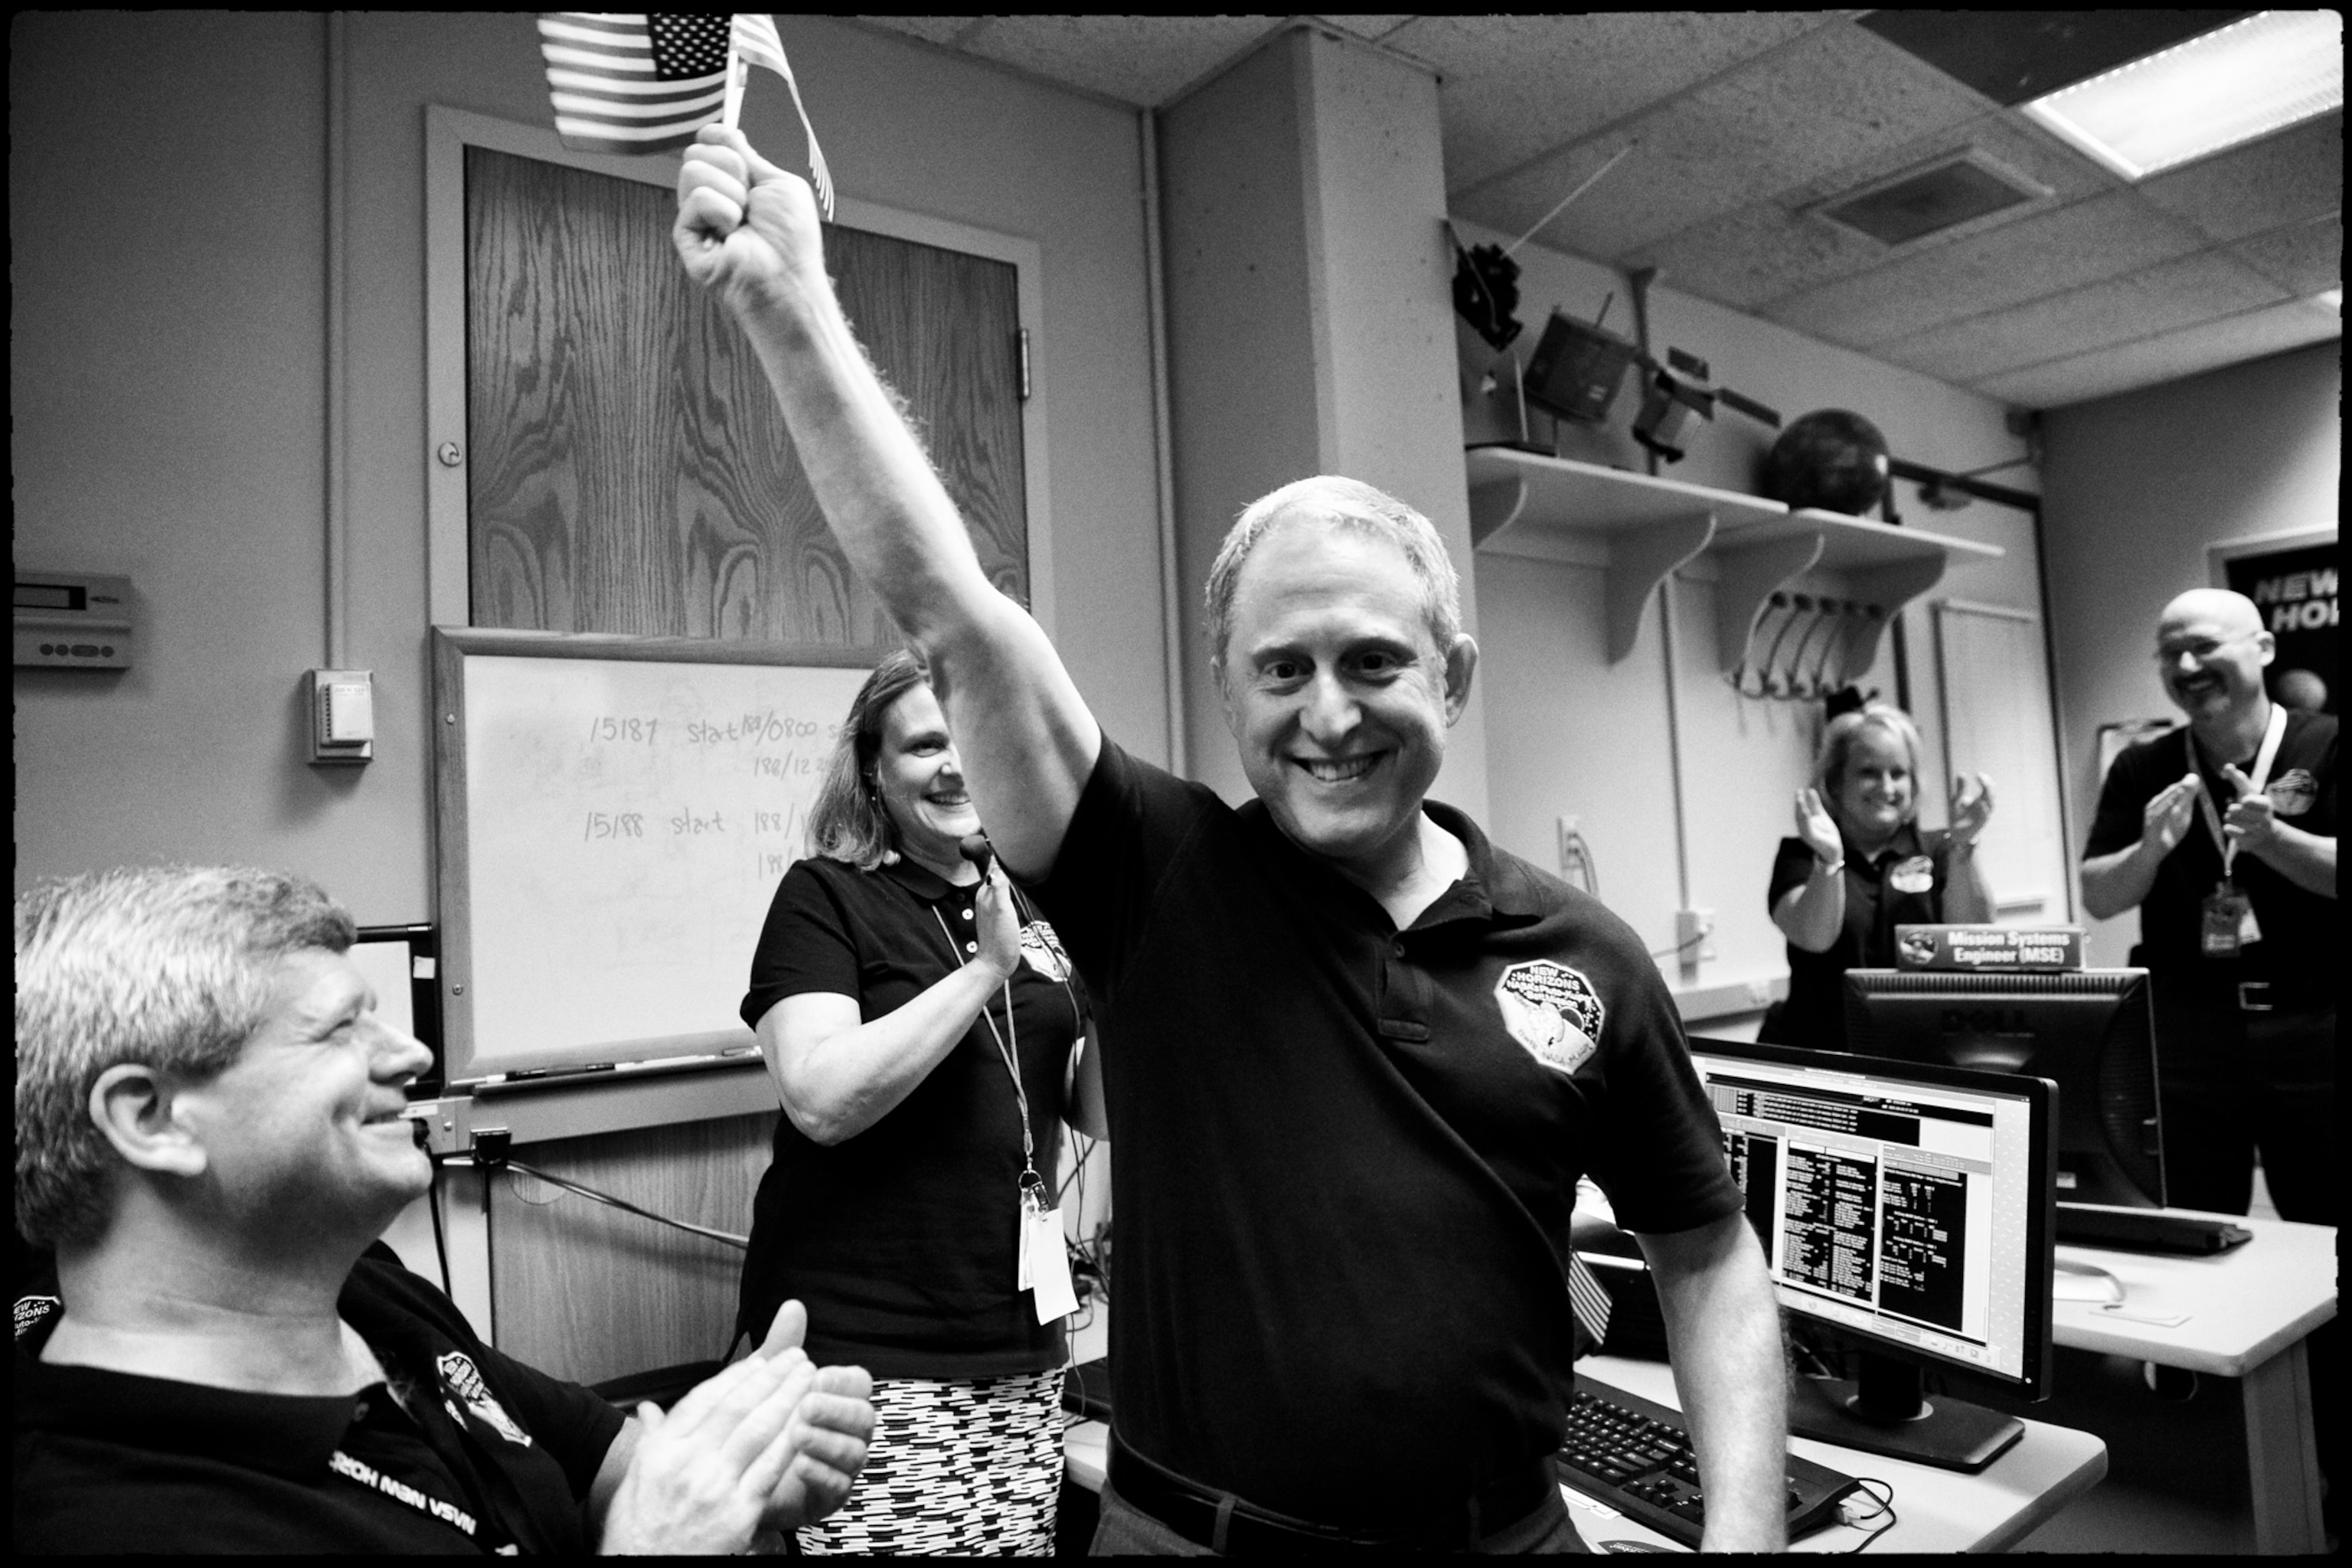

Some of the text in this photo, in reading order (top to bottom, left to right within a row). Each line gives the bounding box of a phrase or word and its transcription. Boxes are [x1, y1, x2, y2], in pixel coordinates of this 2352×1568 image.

[2254, 567, 2338, 604] NEW
[1947, 931, 2070, 949] Mission Systems
[1953, 947, 2066, 965] Engineer (MSE)
[1515, 971, 1581, 991] HORIZONS
[1529, 965, 1560, 978] NEW
[379, 1475, 426, 1511] NEW
[429, 1498, 477, 1536] NASA
